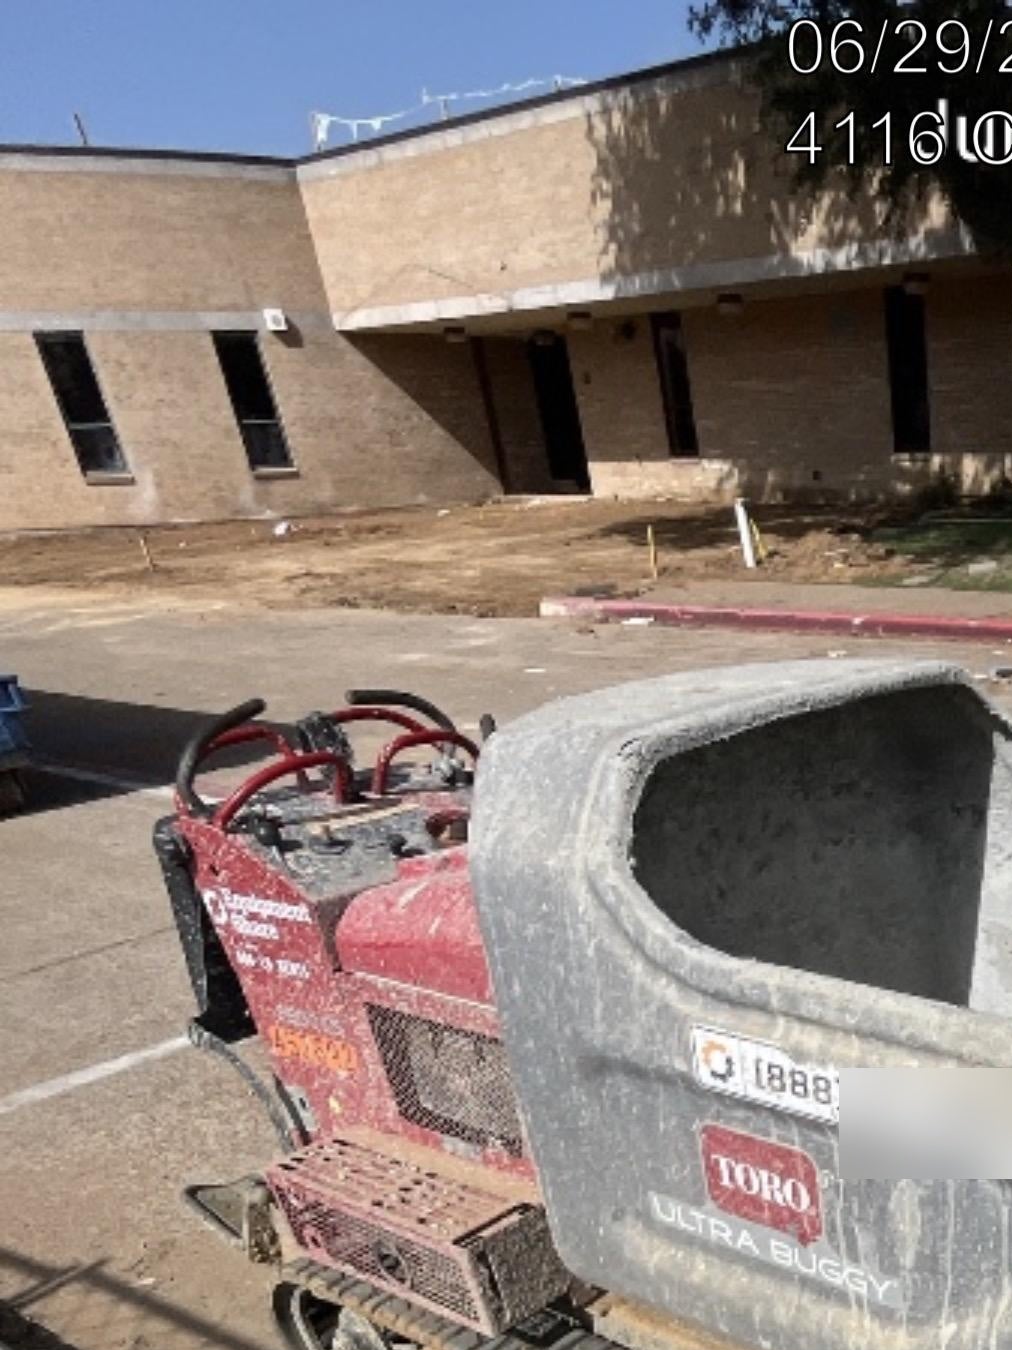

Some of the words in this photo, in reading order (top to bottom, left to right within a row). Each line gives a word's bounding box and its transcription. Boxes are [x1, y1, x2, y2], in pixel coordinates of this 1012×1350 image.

[710, 1152, 812, 1213] TORO
[651, 1196, 760, 1256] ULTRA
[769, 1240, 898, 1301] BUGGY
